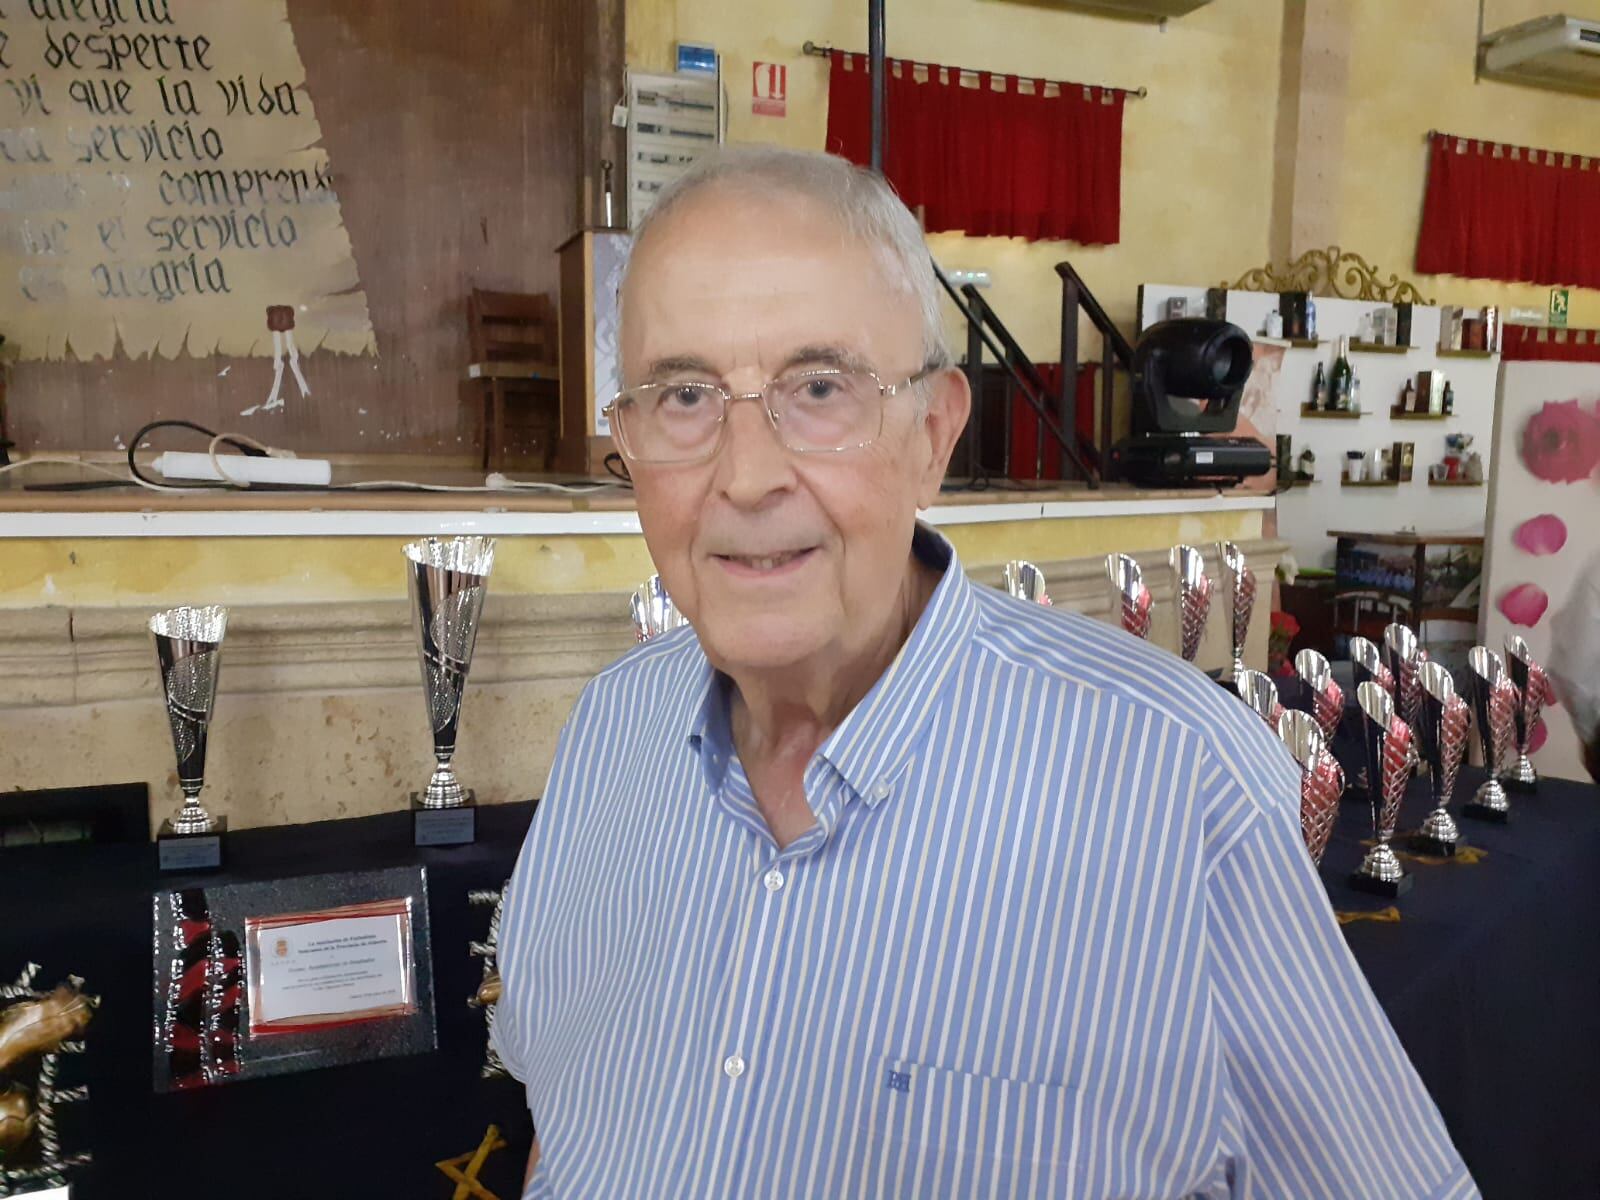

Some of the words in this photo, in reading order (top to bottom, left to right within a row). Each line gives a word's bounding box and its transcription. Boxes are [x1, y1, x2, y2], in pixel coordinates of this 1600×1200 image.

[44, 27, 214, 71] desperte
[68, 79, 134, 116] que
[156, 75, 201, 116] la
[216, 72, 300, 116] vida
[146, 208, 297, 251] servicio
